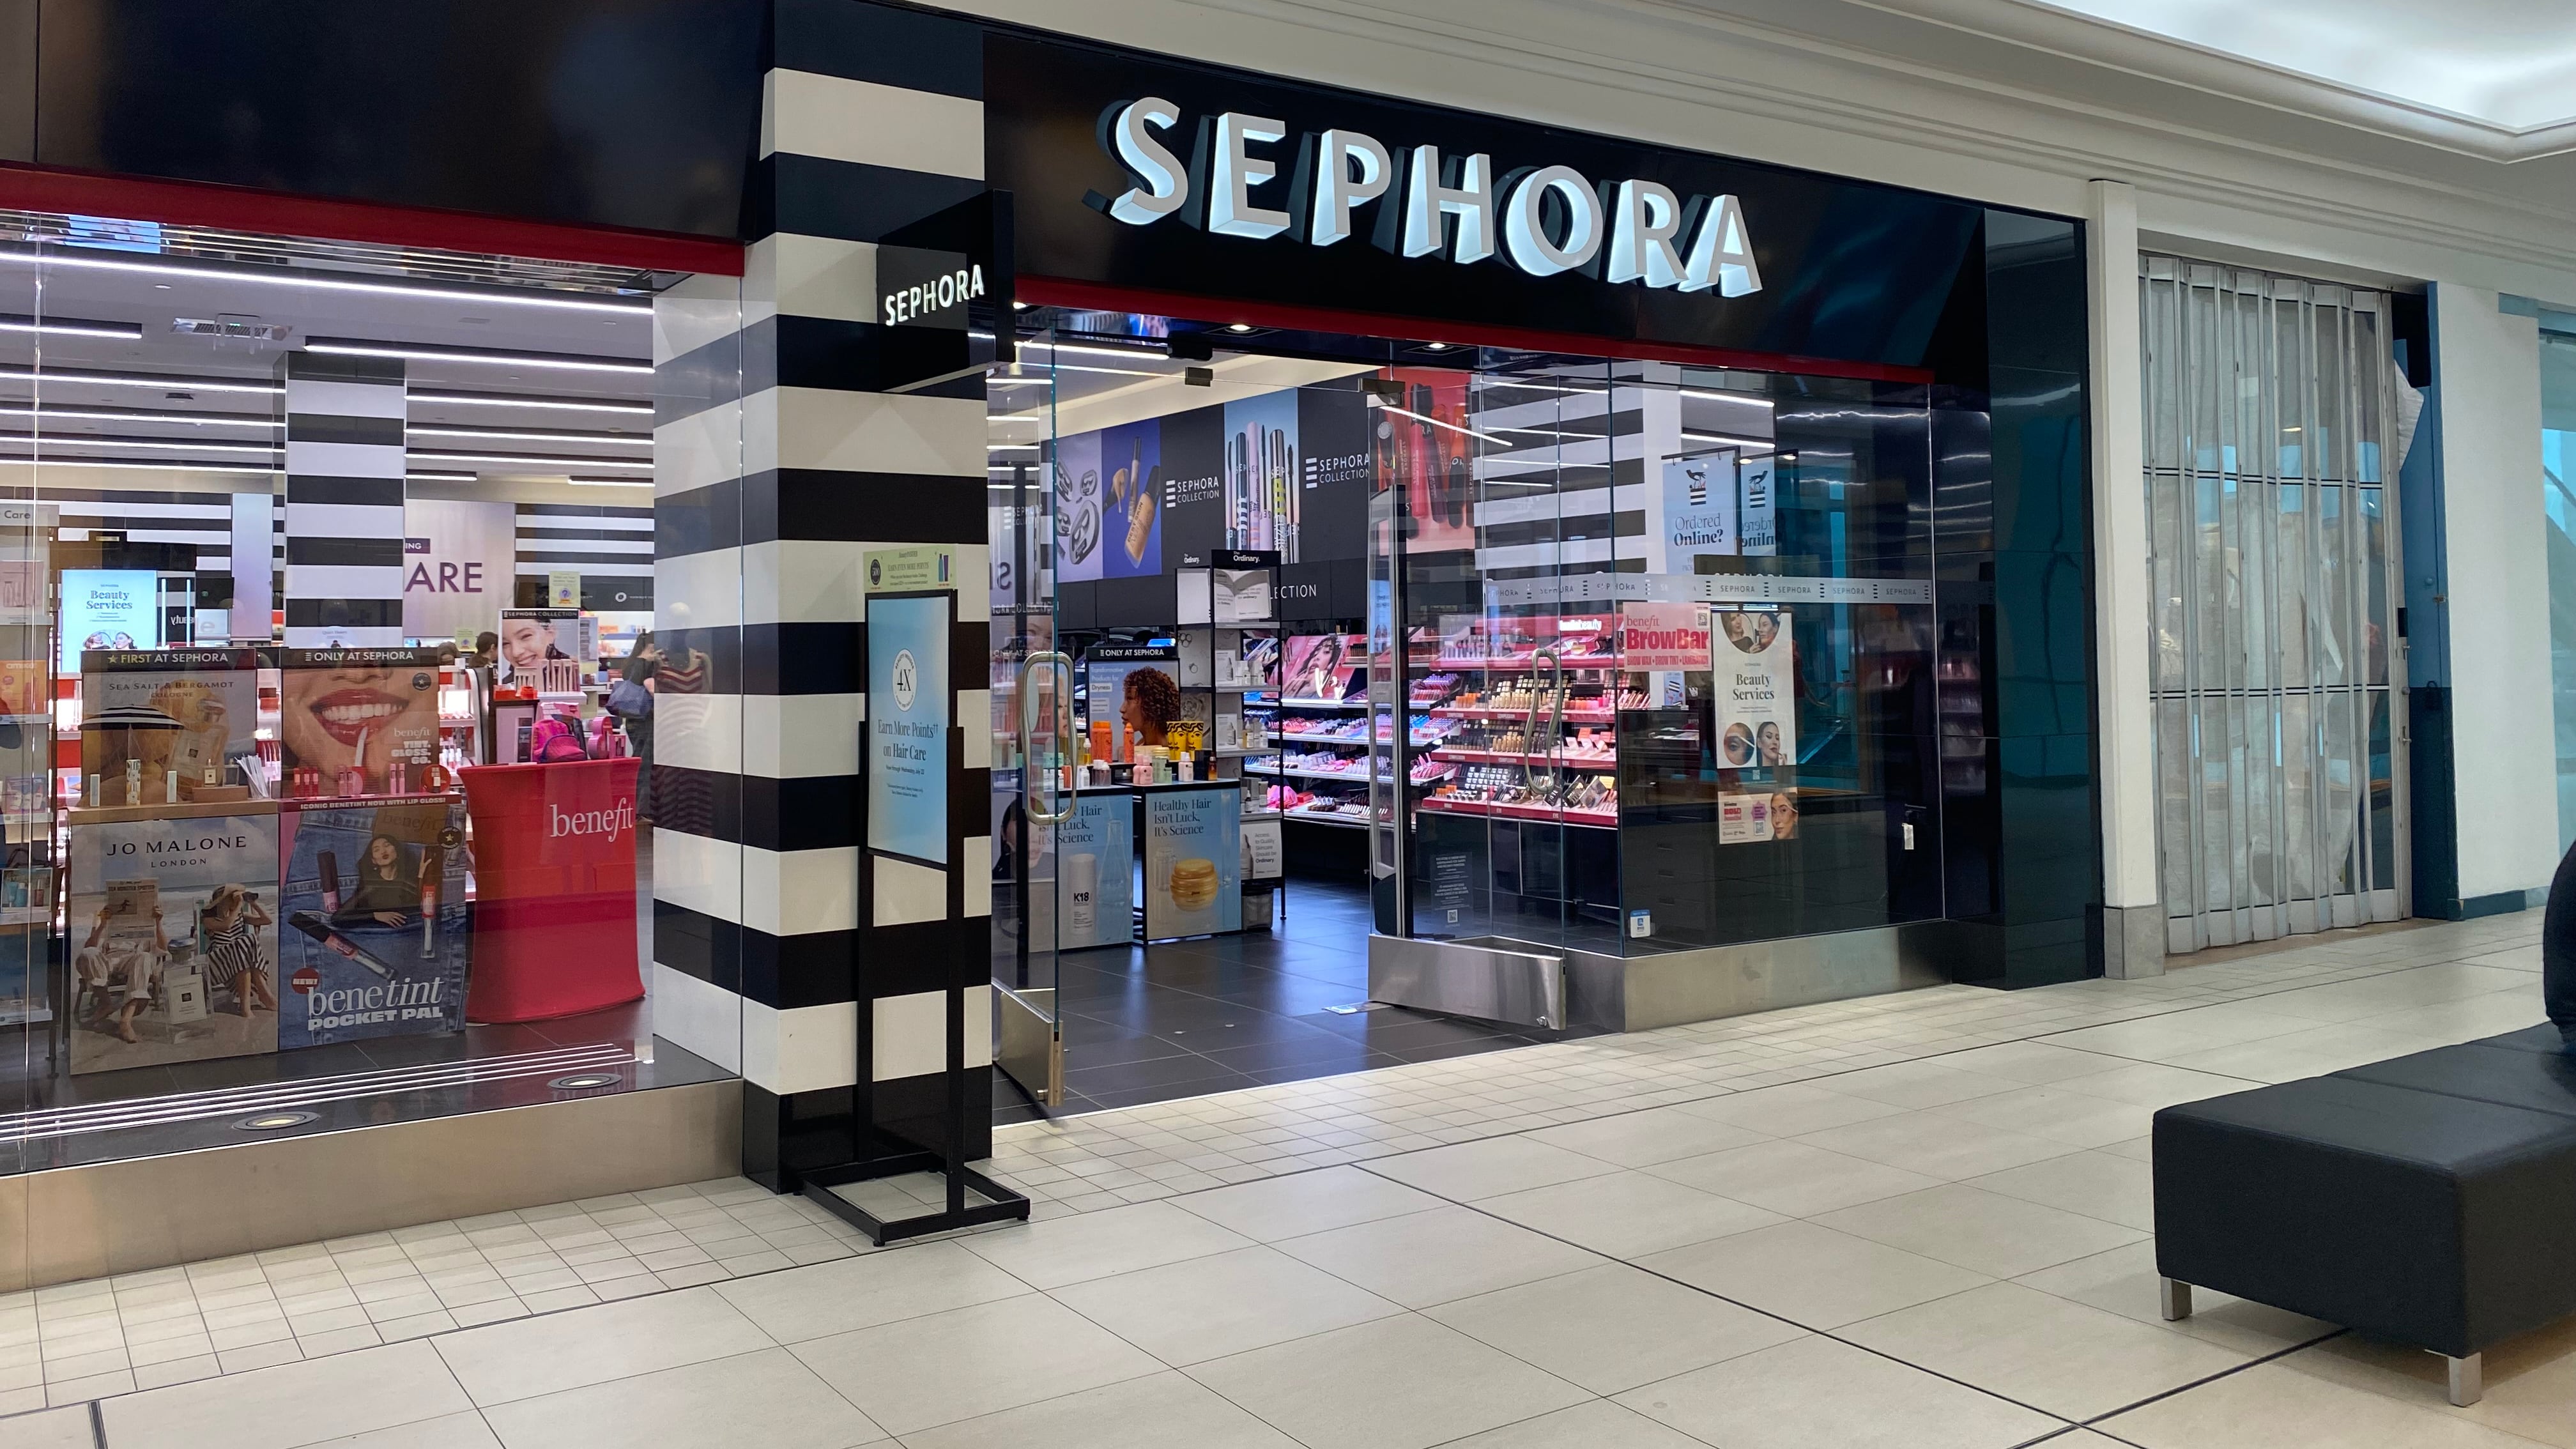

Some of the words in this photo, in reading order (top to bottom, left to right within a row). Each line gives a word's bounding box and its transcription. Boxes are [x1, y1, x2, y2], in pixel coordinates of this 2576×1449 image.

[1109, 96, 1763, 298] SEPHORA
[885, 264, 985, 326] SEPHORA
[1319, 453, 1369, 471] SEPHORA
[1319, 468, 1369, 483] COLLECTION
[1177, 476, 1219, 493] SEPHORA
[1177, 490, 1220, 503] COLLECTION
[4, 510, 31, 519] Care
[1675, 512, 1721, 531] Ordered
[1674, 529, 1724, 547] Online?
[1233, 555, 1260, 564] Ordinary.
[405, 562, 483, 593] ARE
[91, 590, 130, 601] Beauty
[86, 601, 133, 610] Services
[1627, 615, 1660, 629] benefit
[1627, 628, 1709, 650] BrowBar
[121, 654, 151, 663] FIRST
[154, 654, 169, 663] AT
[171, 653, 228, 663] SEPHORA
[314, 652, 344, 661] ONLY
[348, 652, 360, 660] AT
[363, 651, 414, 660] SEPHORA
[1627, 656, 1641, 665] BROW
[1642, 656, 1652, 665] WAX
[1655, 655, 1668, 665] BROW
[133, 682, 159, 690] SALT
[897, 669, 911, 691] 4X
[1736, 673, 1771, 687] Beauty
[1733, 687, 1775, 700] Services
[394, 727, 430, 739] benefit
[878, 719, 893, 734] Earn
[894, 721, 910, 736] More
[391, 748, 431, 756] GLOSS.
[883, 747, 891, 756] on
[893, 743, 908, 759] Hair
[910, 744, 926, 761] Care
[1081, 806, 1102, 816] Hair
[1154, 800, 1189, 812] Healthy
[1192, 799, 1212, 809] Hair
[549, 797, 633, 842] benefit
[1064, 818, 1090, 830] Luck,
[1154, 813, 1174, 824] Isn't
[1176, 813, 1200, 823] Luck,
[1154, 826, 1168, 837] It's
[1169, 825, 1204, 836] Science
[1058, 832, 1094, 844] Science
[107, 843, 136, 856] JO
[146, 836, 247, 854] MALONE
[151, 858, 206, 868] LONDON
[1073, 892, 1089, 902] K18
[307, 977, 445, 1016] benetint
[308, 1009, 397, 1031] POCKET
[402, 1007, 443, 1020] PAL
